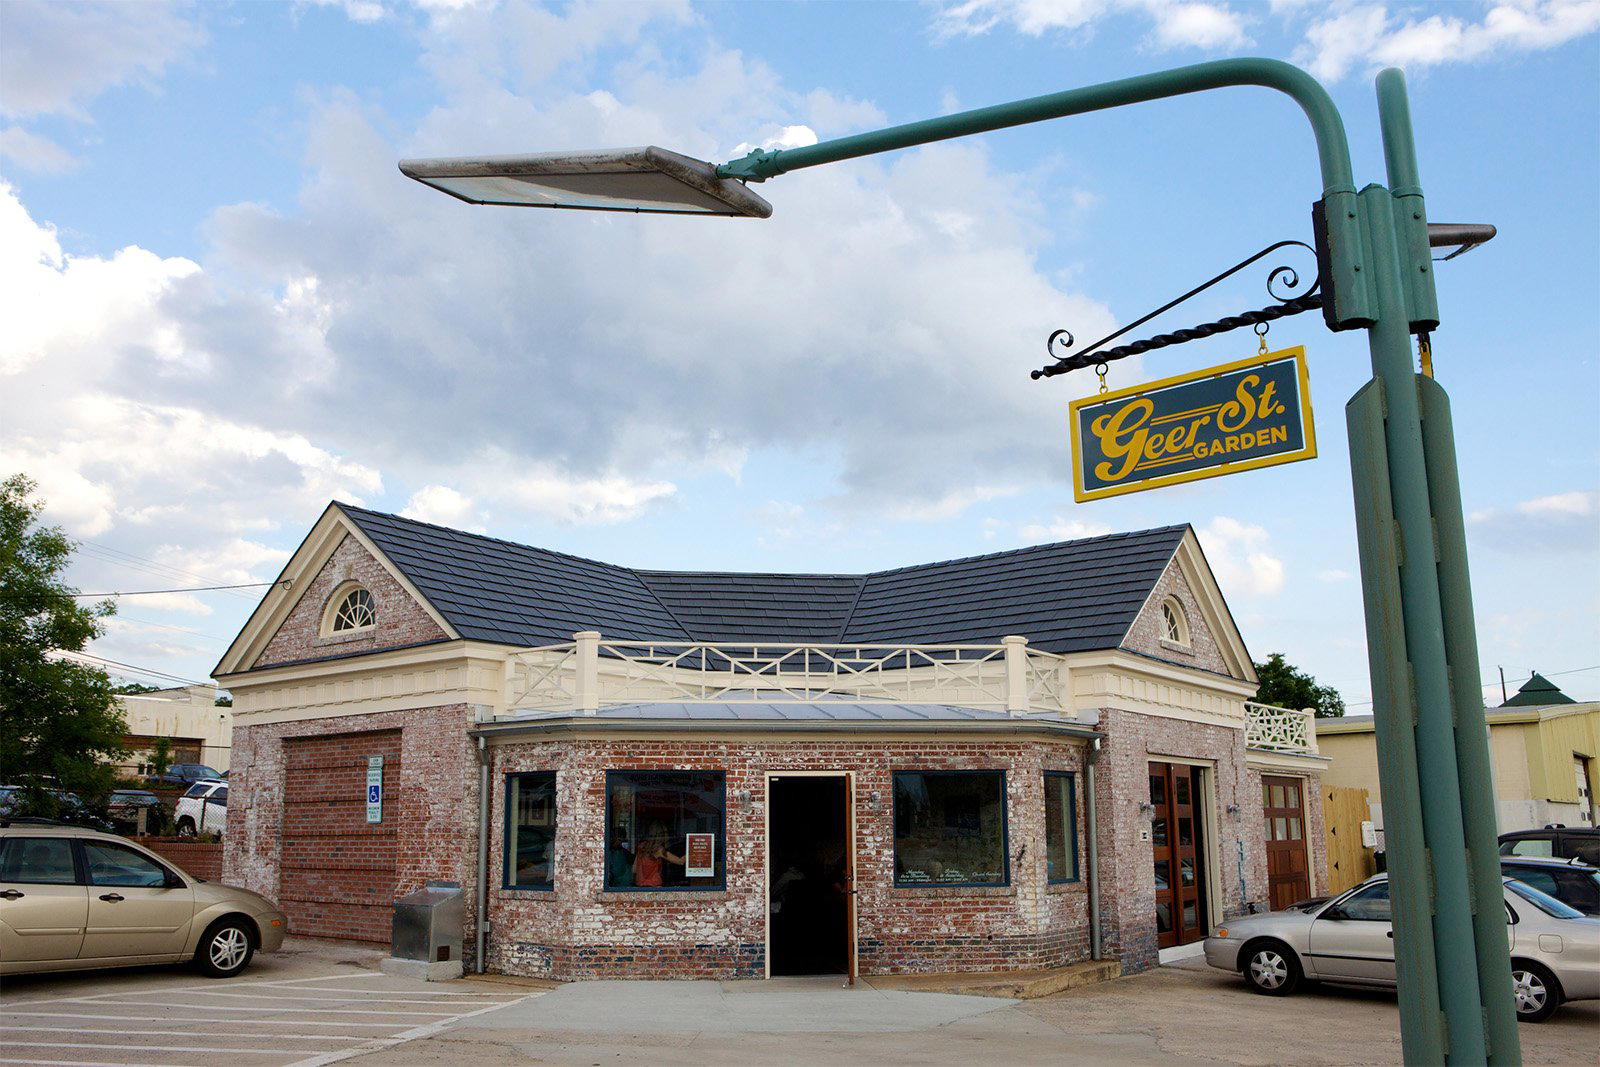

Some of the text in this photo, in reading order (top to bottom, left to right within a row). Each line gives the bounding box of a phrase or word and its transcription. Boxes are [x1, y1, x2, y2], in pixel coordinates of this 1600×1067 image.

[1091, 374, 1286, 481] Geer St.
[1192, 424, 1288, 459] GARDEN
